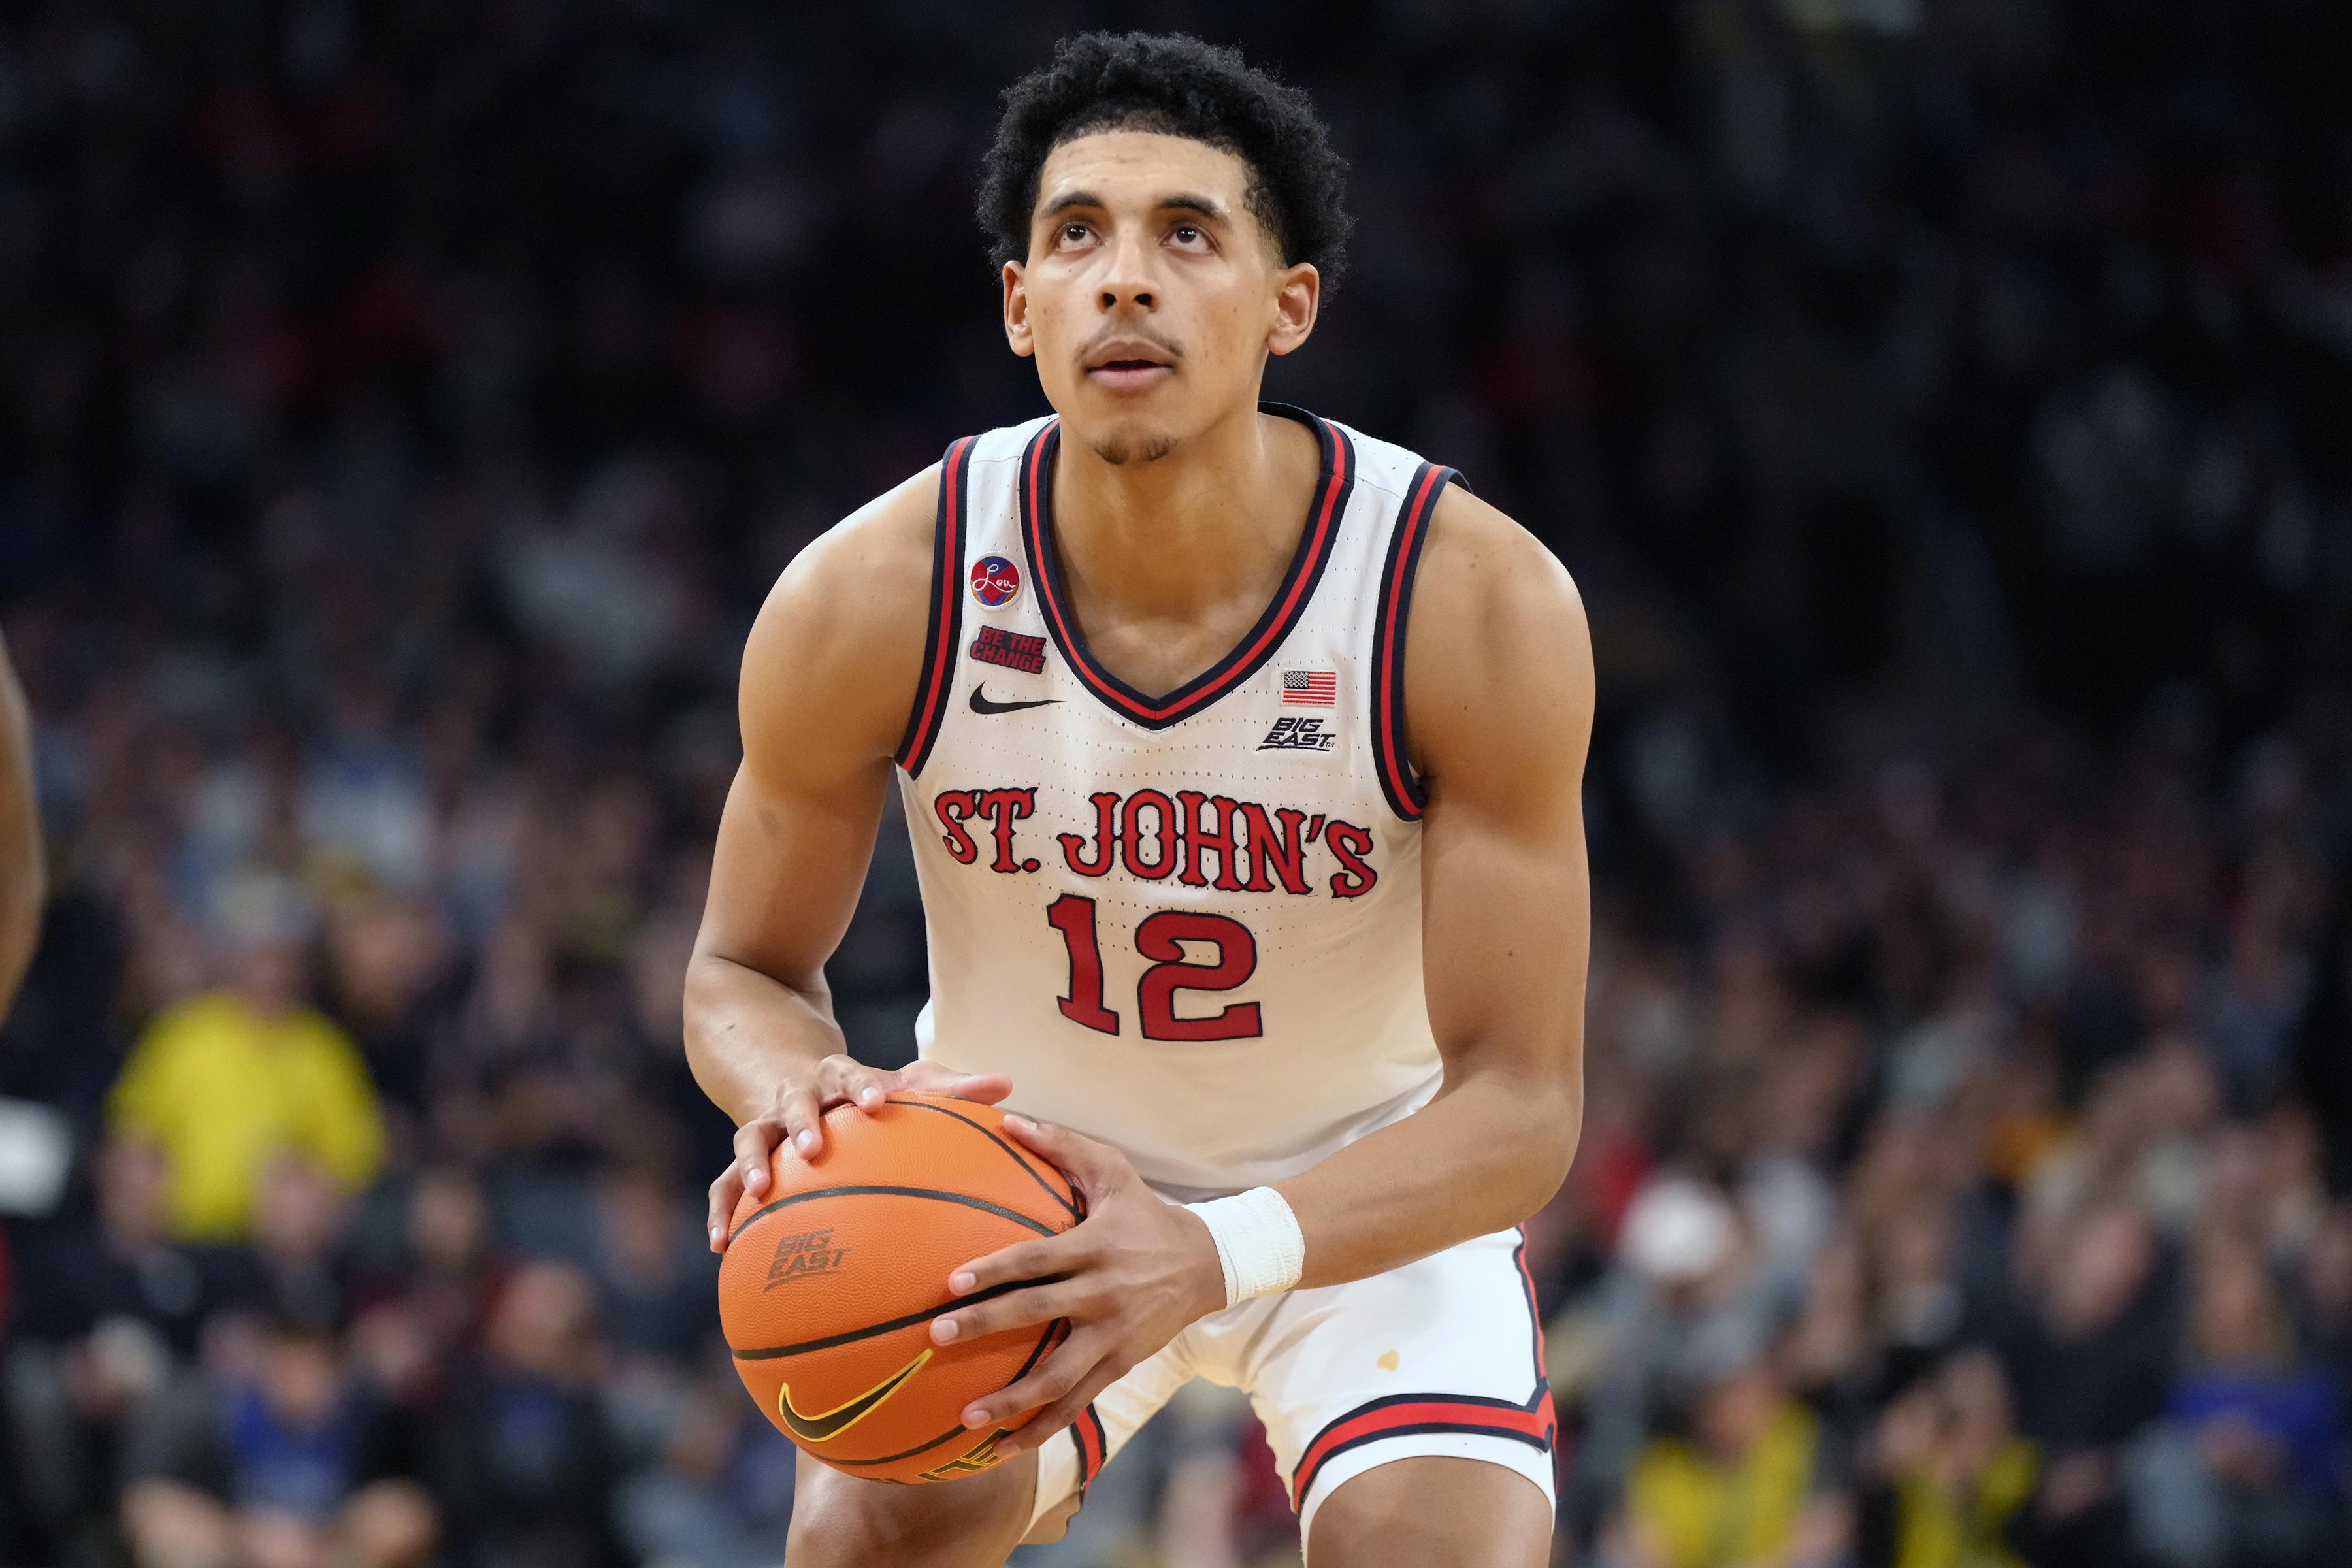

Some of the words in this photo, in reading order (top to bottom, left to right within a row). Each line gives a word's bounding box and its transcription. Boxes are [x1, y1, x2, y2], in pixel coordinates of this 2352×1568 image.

[972, 563, 1017, 593] Lou
[981, 627, 1005, 647] BE
[1009, 632, 1045, 655] THE
[971, 642, 1045, 674] CHANGE
[1262, 731, 1336, 747] EAST
[1271, 717, 1324, 732] BIG
[934, 787, 1041, 874] ST.
[1056, 789, 1378, 898] JOHN'S
[1046, 893, 1264, 1042] 12
[775, 1229, 834, 1257] BIG
[767, 1247, 852, 1280] EAST
